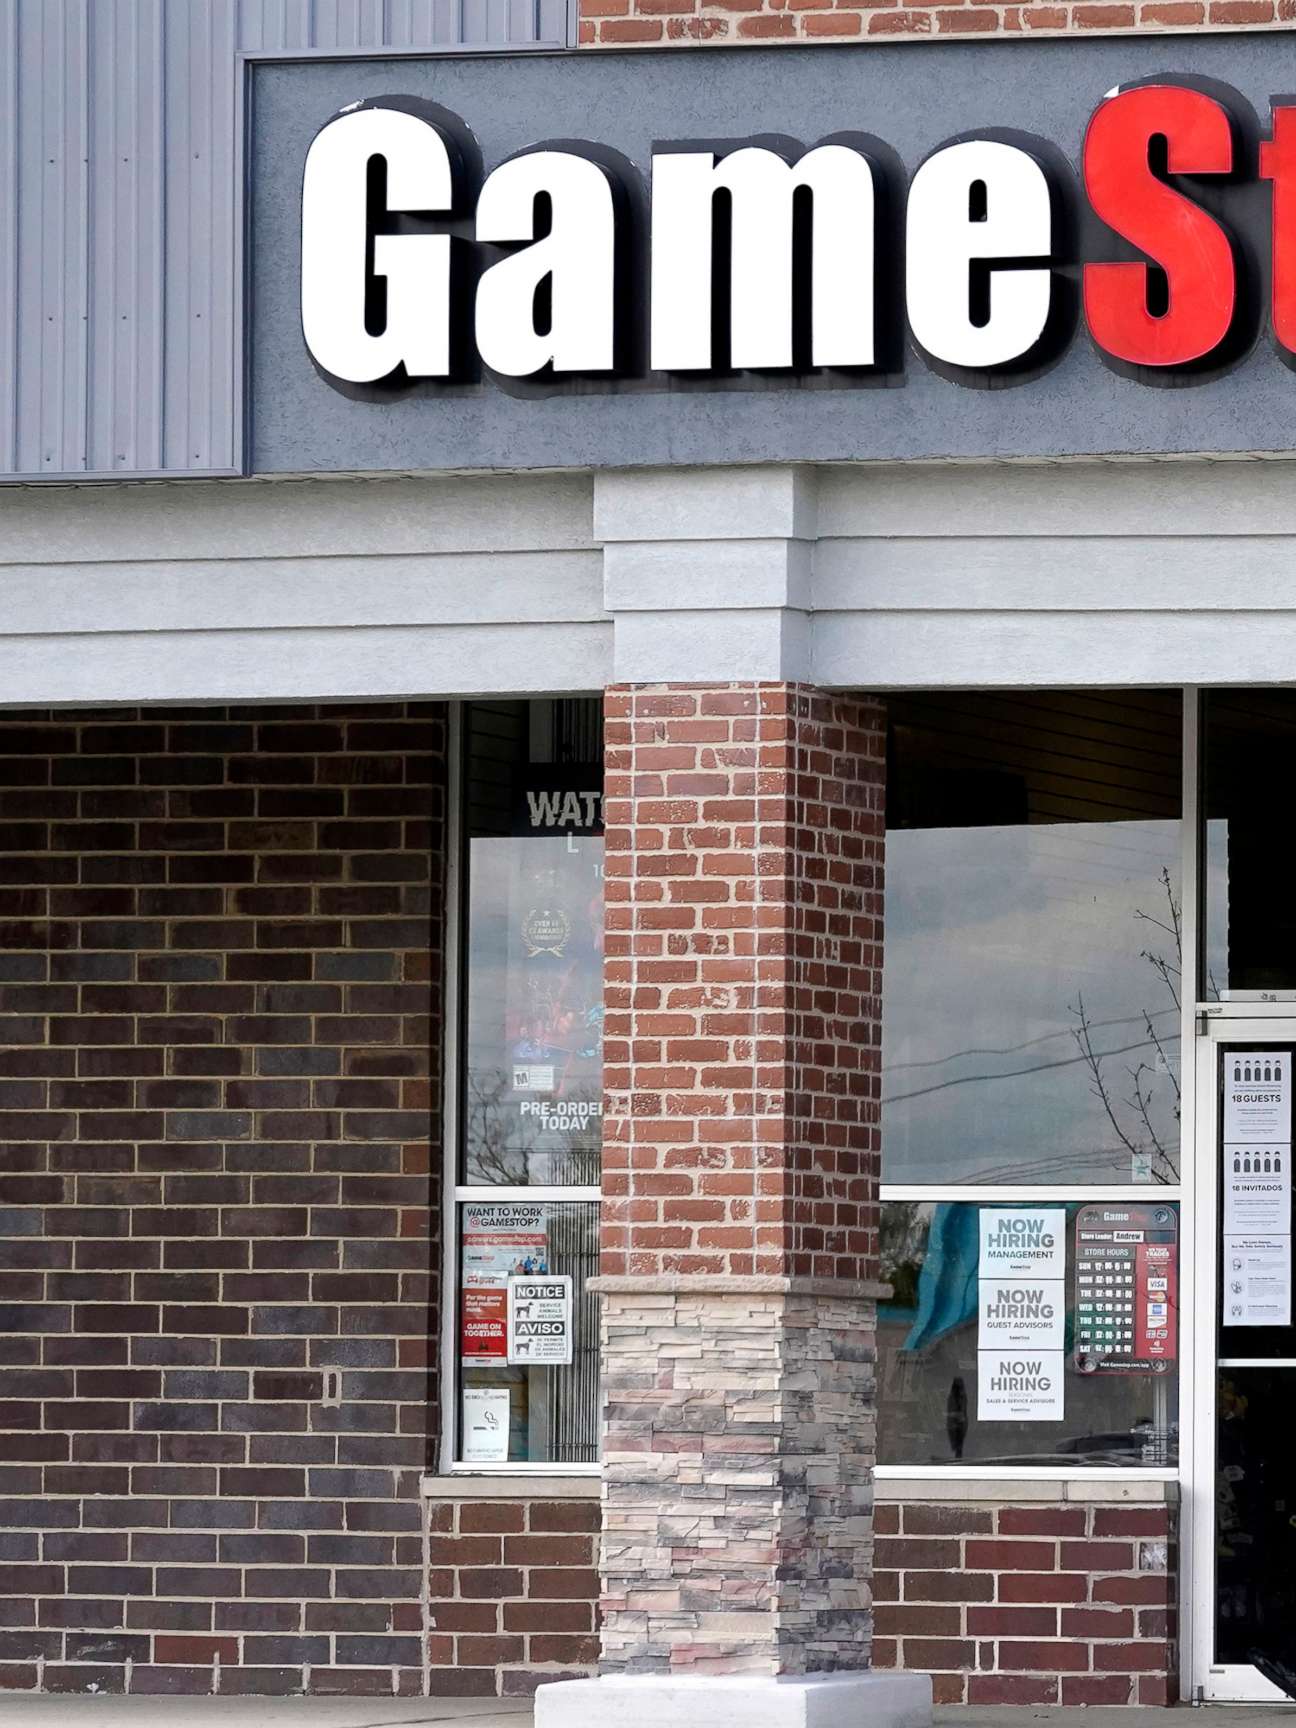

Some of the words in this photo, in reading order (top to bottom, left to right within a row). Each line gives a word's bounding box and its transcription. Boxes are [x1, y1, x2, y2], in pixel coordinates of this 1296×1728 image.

[1232, 1094, 1242, 1103] 18
[1243, 1094, 1282, 1103] GUESTS
[540, 1116, 589, 1130] TODAY
[1241, 1184, 1283, 1192] INVITADOS
[467, 1207, 495, 1217] WANT
[497, 1207, 511, 1217] TO
[512, 1207, 543, 1217] WORK
[998, 1218, 1045, 1234] NOW
[987, 1233, 1055, 1248] HIRING
[1115, 1232, 1141, 1241] Andrew
[987, 1250, 1054, 1259] MANAGEMENT
[1106, 1247, 1129, 1256] HOURS
[516, 1286, 563, 1297] NOTICE
[997, 1289, 1044, 1304] NOW
[987, 1304, 1054, 1319] HIRING
[517, 1323, 563, 1334] AVISO
[987, 1321, 1011, 1329] GUEST
[1013, 1321, 1053, 1329] ADVISORS
[999, 1361, 1042, 1376] NOW
[990, 1376, 1052, 1391] HIRING
